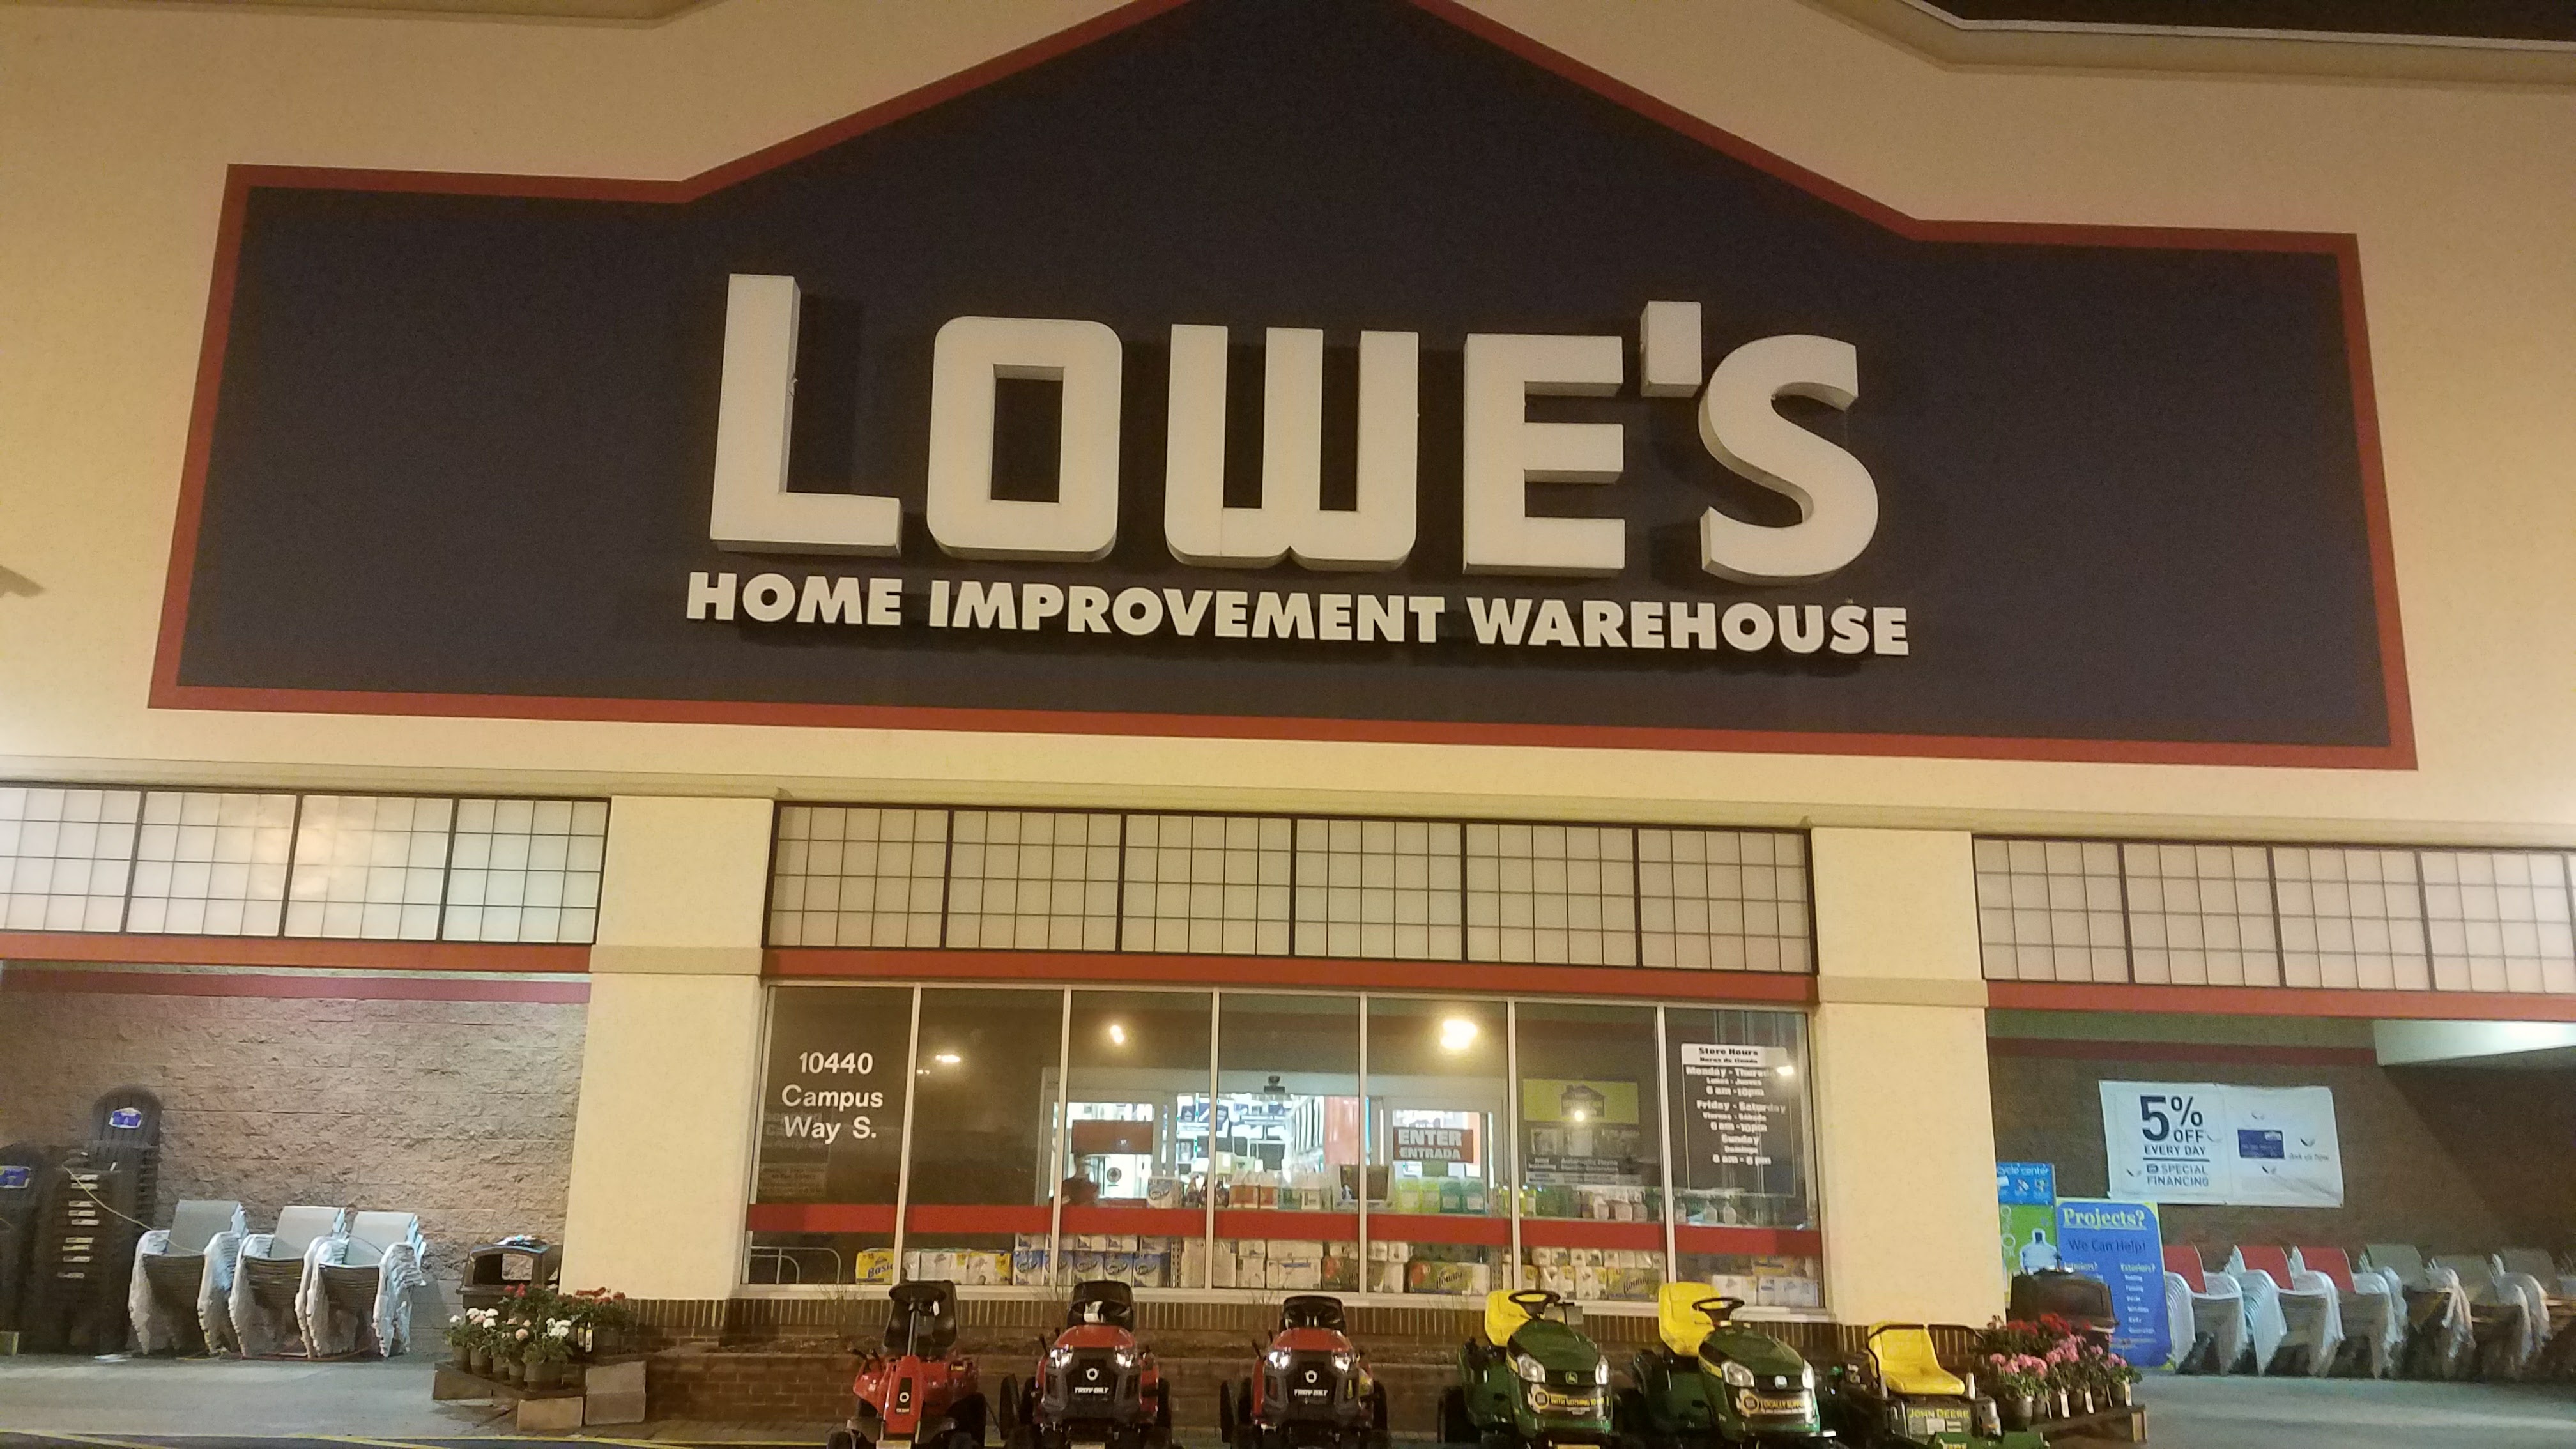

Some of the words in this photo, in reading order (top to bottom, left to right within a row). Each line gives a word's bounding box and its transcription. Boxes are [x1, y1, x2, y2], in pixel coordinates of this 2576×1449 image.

[710, 274, 1878, 585] LOWE'S
[686, 571, 902, 625] HOME
[929, 579, 1445, 643] IMPROVEMENT
[1466, 597, 1909, 656] WAREHOUSE
[799, 1052, 873, 1074] 10440
[781, 1084, 884, 1112] Campus
[2140, 1096, 2203, 1142] 5%
[785, 1116, 841, 1144] Way
[852, 1116, 877, 1138] S.
[1398, 1129, 1462, 1146] ENTER
[2174, 1129, 2204, 1143] OFF
[1399, 1147, 1462, 1160] ENTRADA
[2144, 1145, 2180, 1156] EVERY
[2184, 1146, 2205, 1155] DAY
[2161, 1165, 2208, 1175] SPECIAL
[2147, 1176, 2209, 1187] FINANCING
[2062, 1208, 2145, 1230] Projects?
[2068, 1238, 2088, 1250] We
[2092, 1239, 2113, 1252] Can
[2116, 1239, 2146, 1254] Help!
[1909, 1409, 1935, 1418] JOHN
[1936, 1408, 1970, 1419] DEERE
